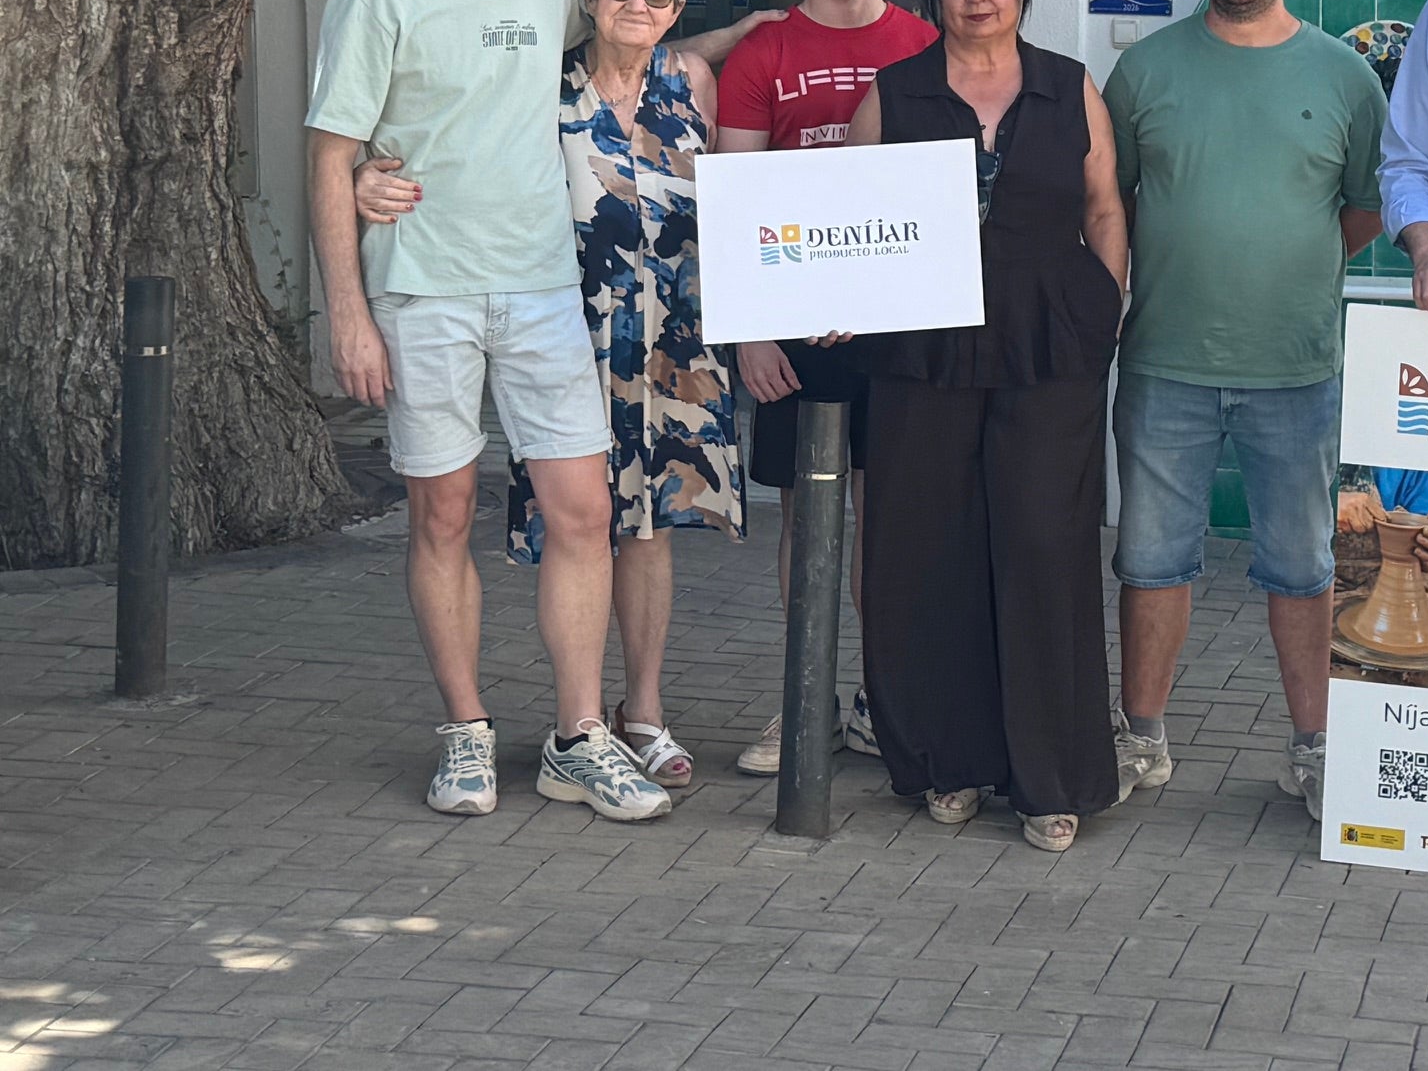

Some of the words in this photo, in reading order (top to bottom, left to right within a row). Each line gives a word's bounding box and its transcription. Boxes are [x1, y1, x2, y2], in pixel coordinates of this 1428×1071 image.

[807, 218, 920, 248] DENÍJAR
[809, 247, 871, 261] PRODUCTO
[874, 245, 909, 256] LOCAL
